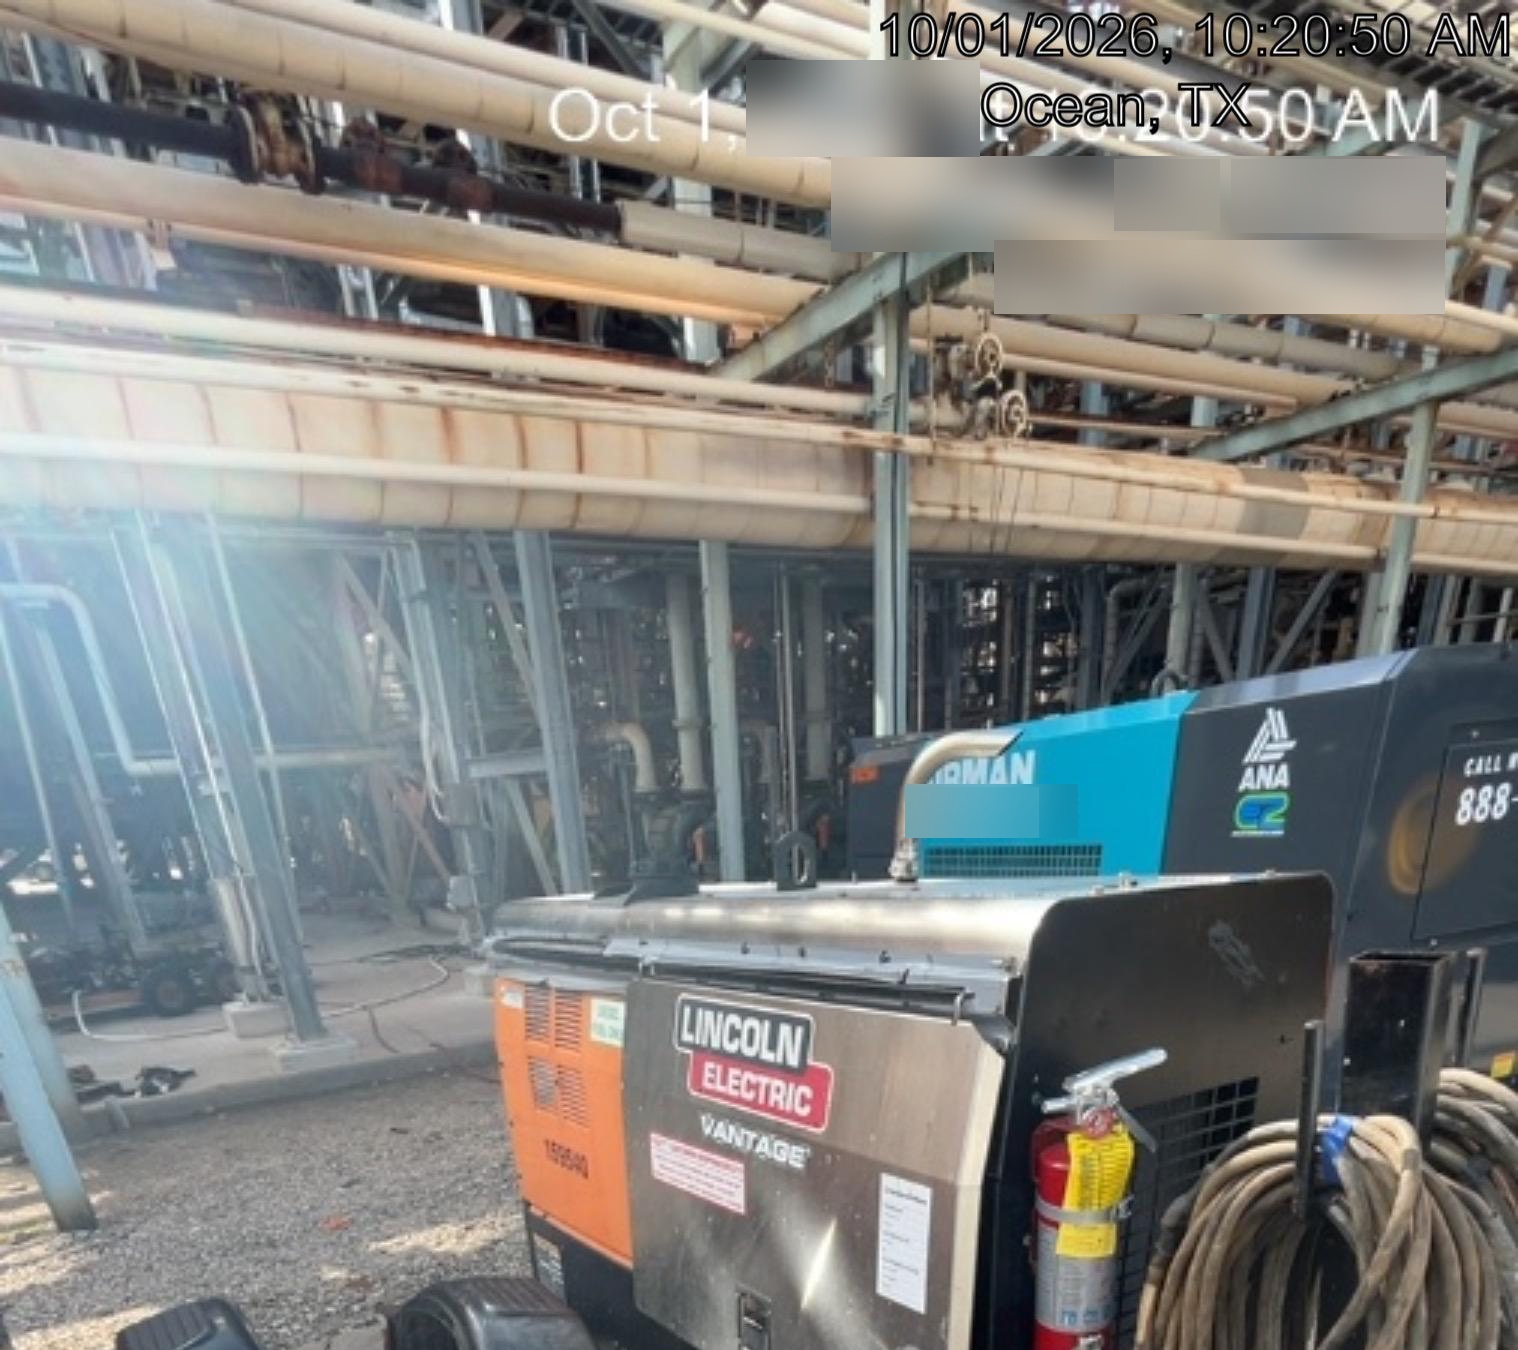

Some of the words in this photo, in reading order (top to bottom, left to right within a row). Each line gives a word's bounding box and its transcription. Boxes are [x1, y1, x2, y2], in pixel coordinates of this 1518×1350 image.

[1238, 763, 1291, 792] ANA
[1463, 754, 1502, 778] CALL
[680, 1004, 805, 1069] LINCOLN
[701, 1060, 814, 1118] ELECTRIC
[700, 1112, 809, 1170] VANTAGE
